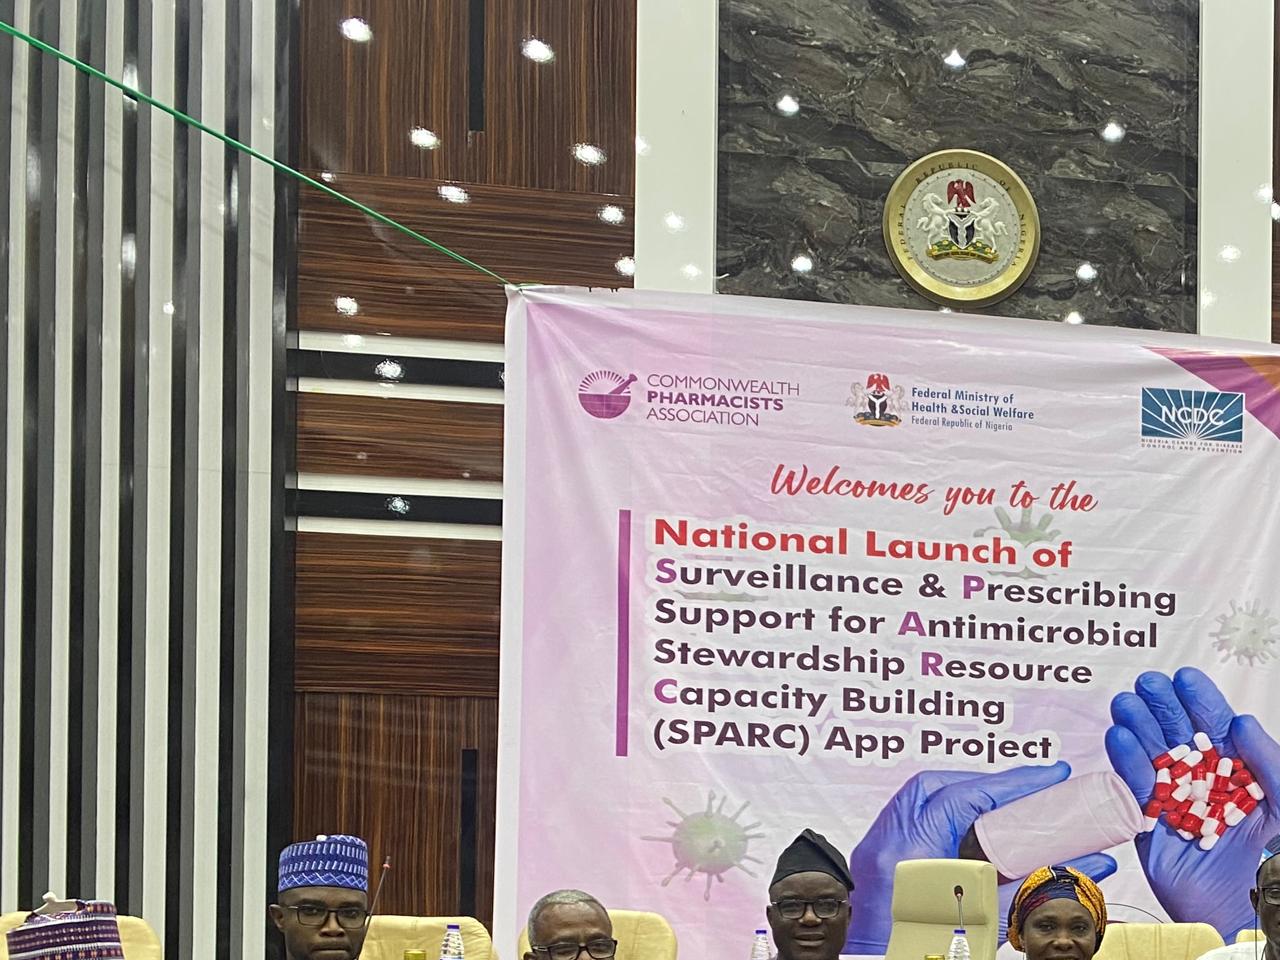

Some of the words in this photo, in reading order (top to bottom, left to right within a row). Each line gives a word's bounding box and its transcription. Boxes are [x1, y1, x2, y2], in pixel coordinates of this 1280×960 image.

[647, 374, 800, 396] COMMONWEALTH
[648, 391, 784, 411] PHARMACISTS
[912, 387, 951, 399] Federal
[955, 390, 998, 405] Ministry
[1003, 394, 1014, 404] of
[647, 408, 759, 426] ASSOCIATION
[912, 404, 947, 414] Health
[951, 405, 990, 417] &Social
[994, 408, 1034, 420] Welfare
[912, 416, 940, 426] Federal
[942, 417, 972, 429] Republic
[975, 421, 983, 429] of
[985, 421, 1013, 432] Nigeria
[1162, 406, 1224, 426] NCDC
[770, 463, 934, 504] Welcomes
[944, 485, 996, 515] you
[1009, 480, 1038, 509] to
[1049, 480, 1099, 512] the
[655, 519, 847, 555] National
[866, 530, 1017, 565] Launch
[1032, 541, 1072, 569] of
[655, 558, 903, 596] Surveillance
[919, 573, 947, 598] &
[963, 575, 1177, 617] Prescribing
[655, 600, 815, 634] Support
[829, 610, 885, 635] for
[898, 611, 1157, 648] Antimicrobial
[654, 639, 906, 679] Stewardship
[921, 652, 1093, 684] Resource
[654, 679, 828, 716] Capacity
[842, 688, 1005, 725] Building
[653, 719, 810, 757] (SPARC)
[825, 726, 905, 760] App
[921, 730, 1051, 764] Project
